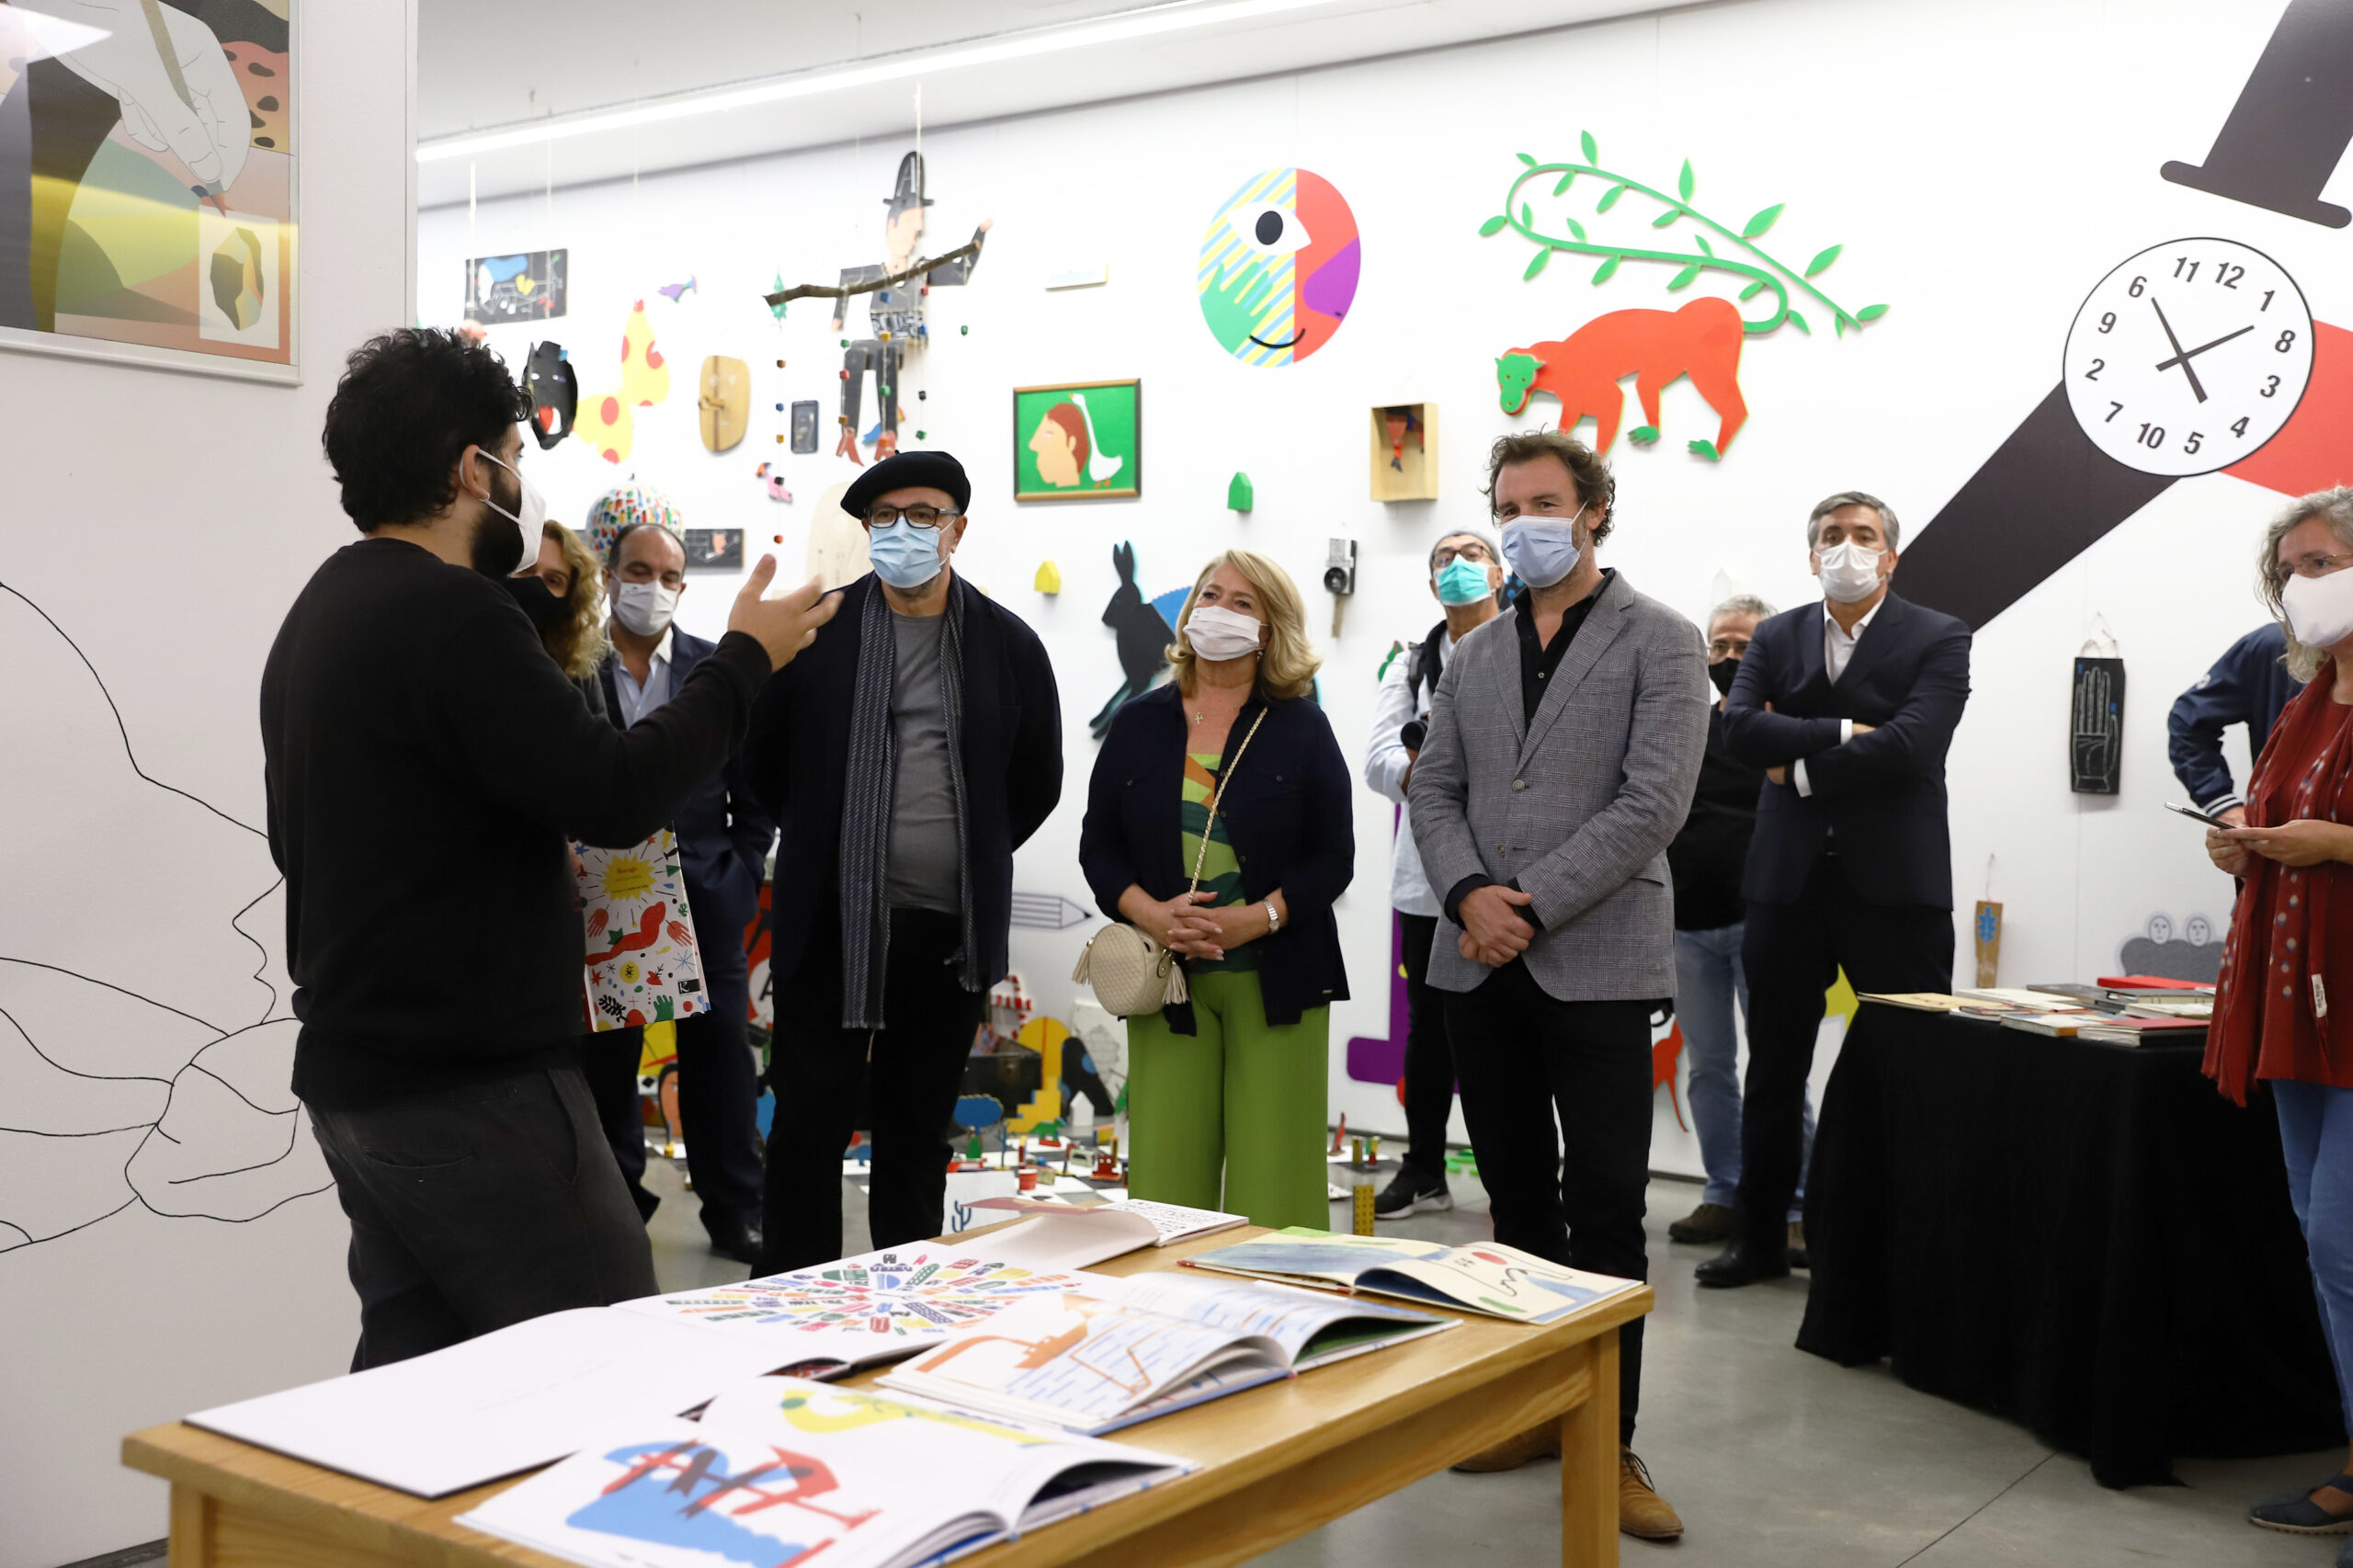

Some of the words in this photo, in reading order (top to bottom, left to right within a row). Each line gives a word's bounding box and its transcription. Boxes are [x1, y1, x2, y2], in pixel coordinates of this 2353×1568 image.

[2174, 257, 2200, 283] 11
[2215, 263, 2245, 290] 12
[2129, 276, 2147, 298] 6
[2260, 290, 2275, 312] 1
[2097, 312, 2117, 334] 9
[2274, 329, 2296, 353] 8
[2085, 358, 2105, 381] 2
[2260, 375, 2281, 398] 3
[2105, 401, 2123, 423] 7
[2137, 423, 2165, 449] 10
[2231, 416, 2250, 437] 4
[2184, 431, 2204, 455] 5
